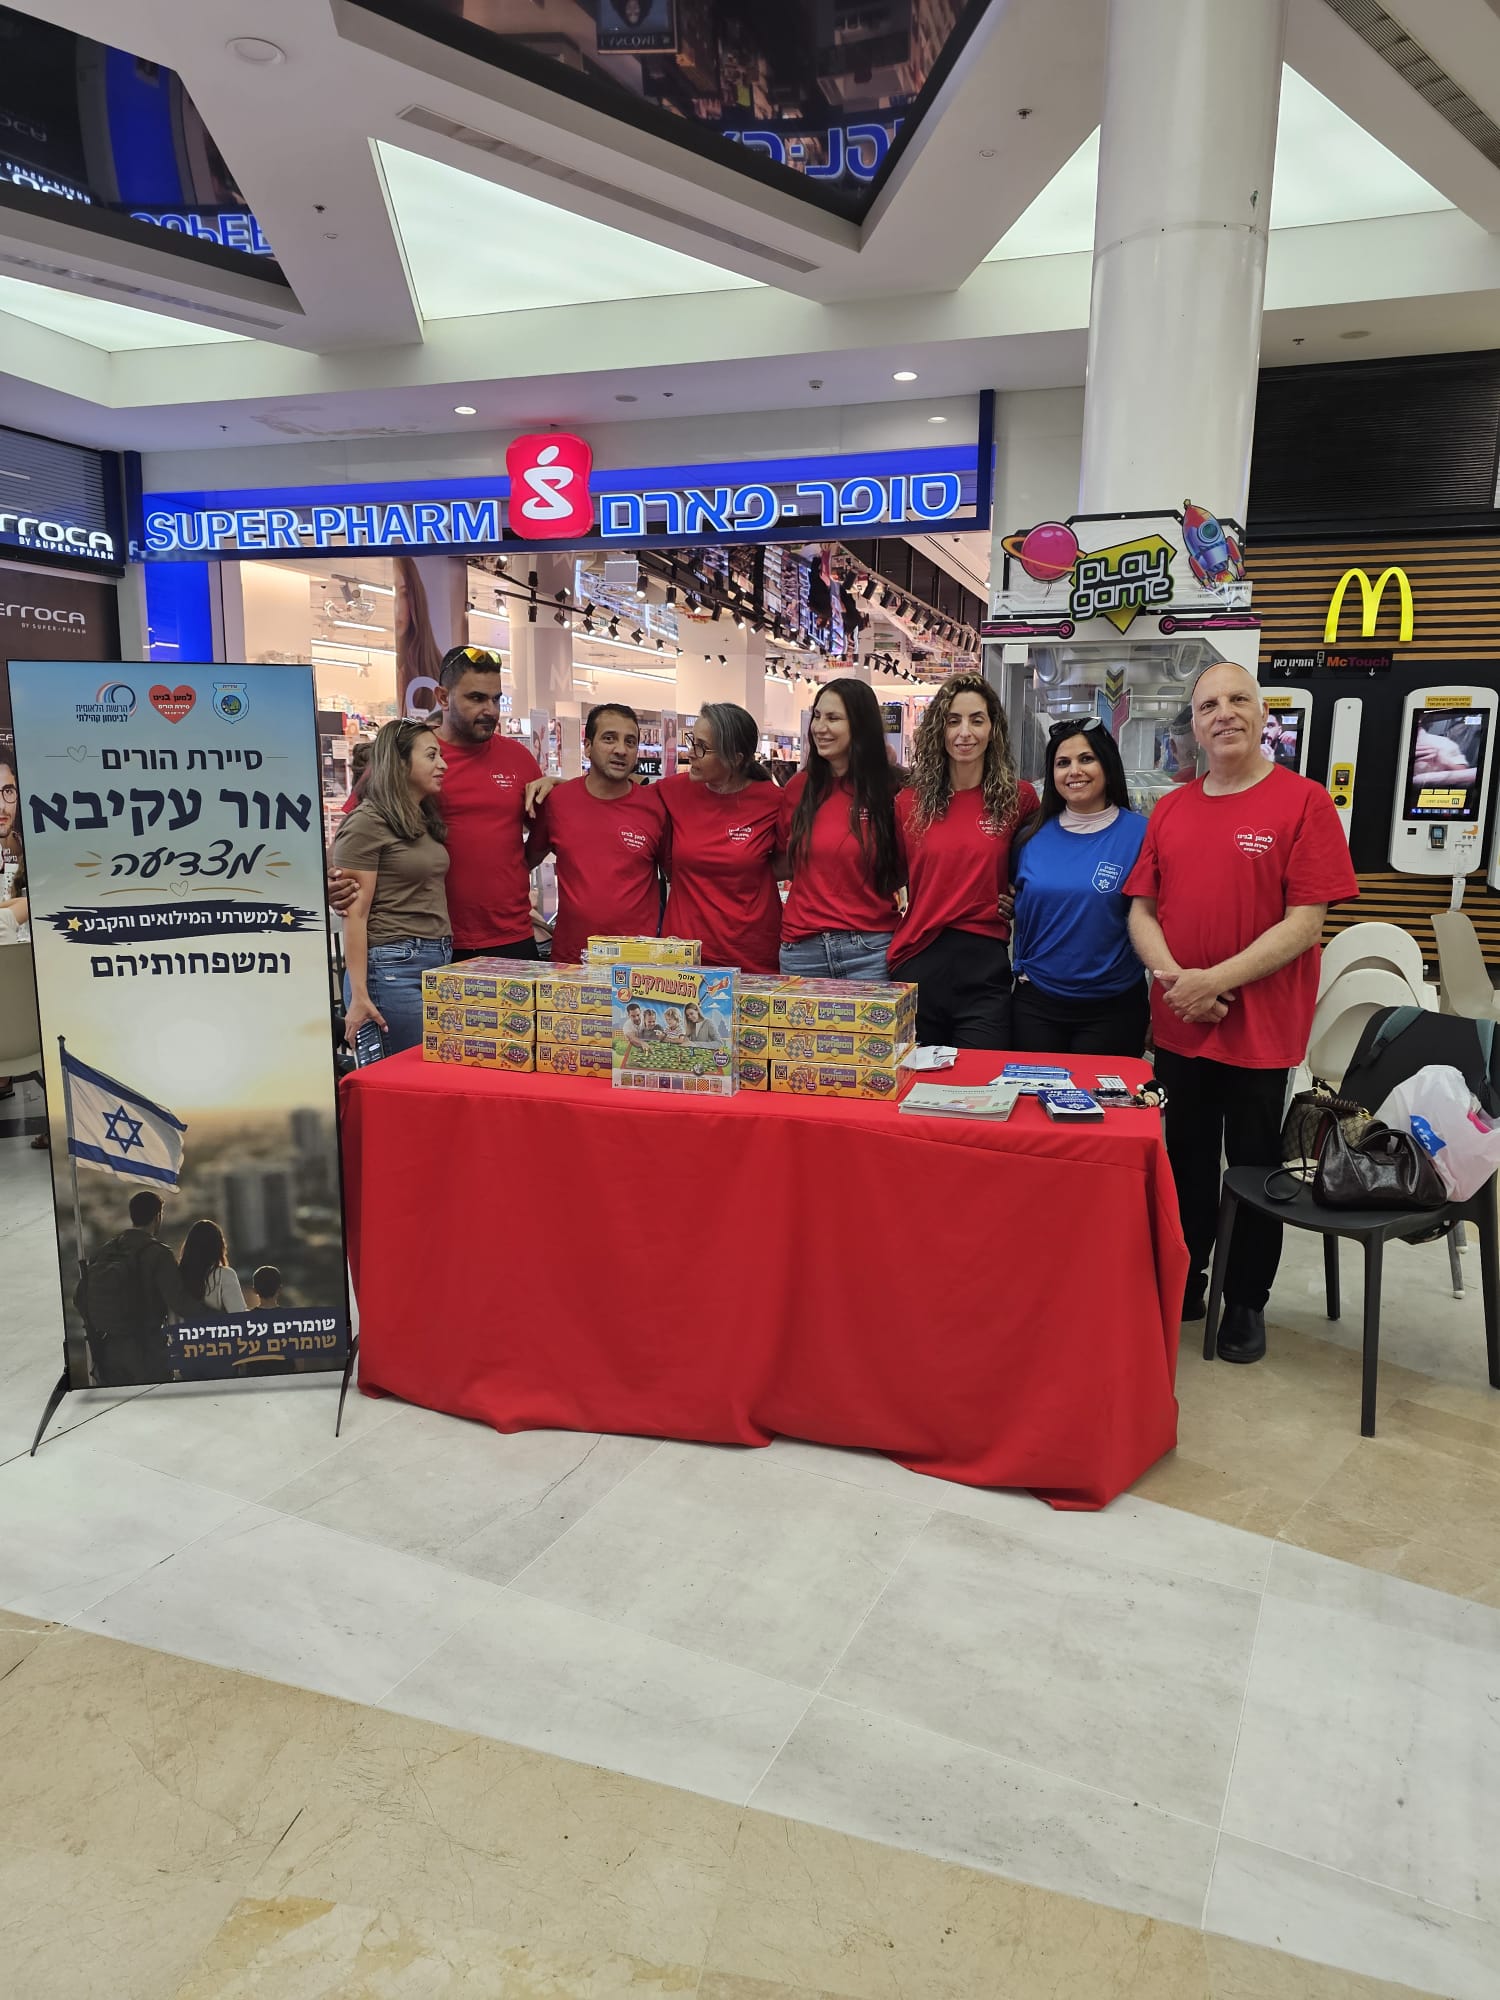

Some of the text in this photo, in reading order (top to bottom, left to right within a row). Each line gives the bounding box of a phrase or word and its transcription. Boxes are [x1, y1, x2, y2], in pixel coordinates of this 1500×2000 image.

[600, 473, 963, 538] סופר-פארם
[145, 500, 502, 551] SUPER-PHARM
[19, 536, 114, 560] BY SUPER-PHARM
[1273, 659, 1288, 669] כאן
[1326, 656, 1390, 667] McTouch
[76, 713, 101, 723] קהילתי
[102, 748, 263, 770] סיירת הורים
[29, 787, 312, 836] אור עקיבא
[110, 839, 266, 879] מצדיעה
[84, 909, 278, 932] למשרתי המילואים והקבע
[90, 952, 291, 978] ומשפחותיהם
[631, 972, 698, 998] המשחקים
[678, 973, 695, 981] אוסף
[620, 989, 629, 1000] 2
[179, 1318, 336, 1341] שומרים על המדינה
[184, 1335, 337, 1358] שומרים על הבית
